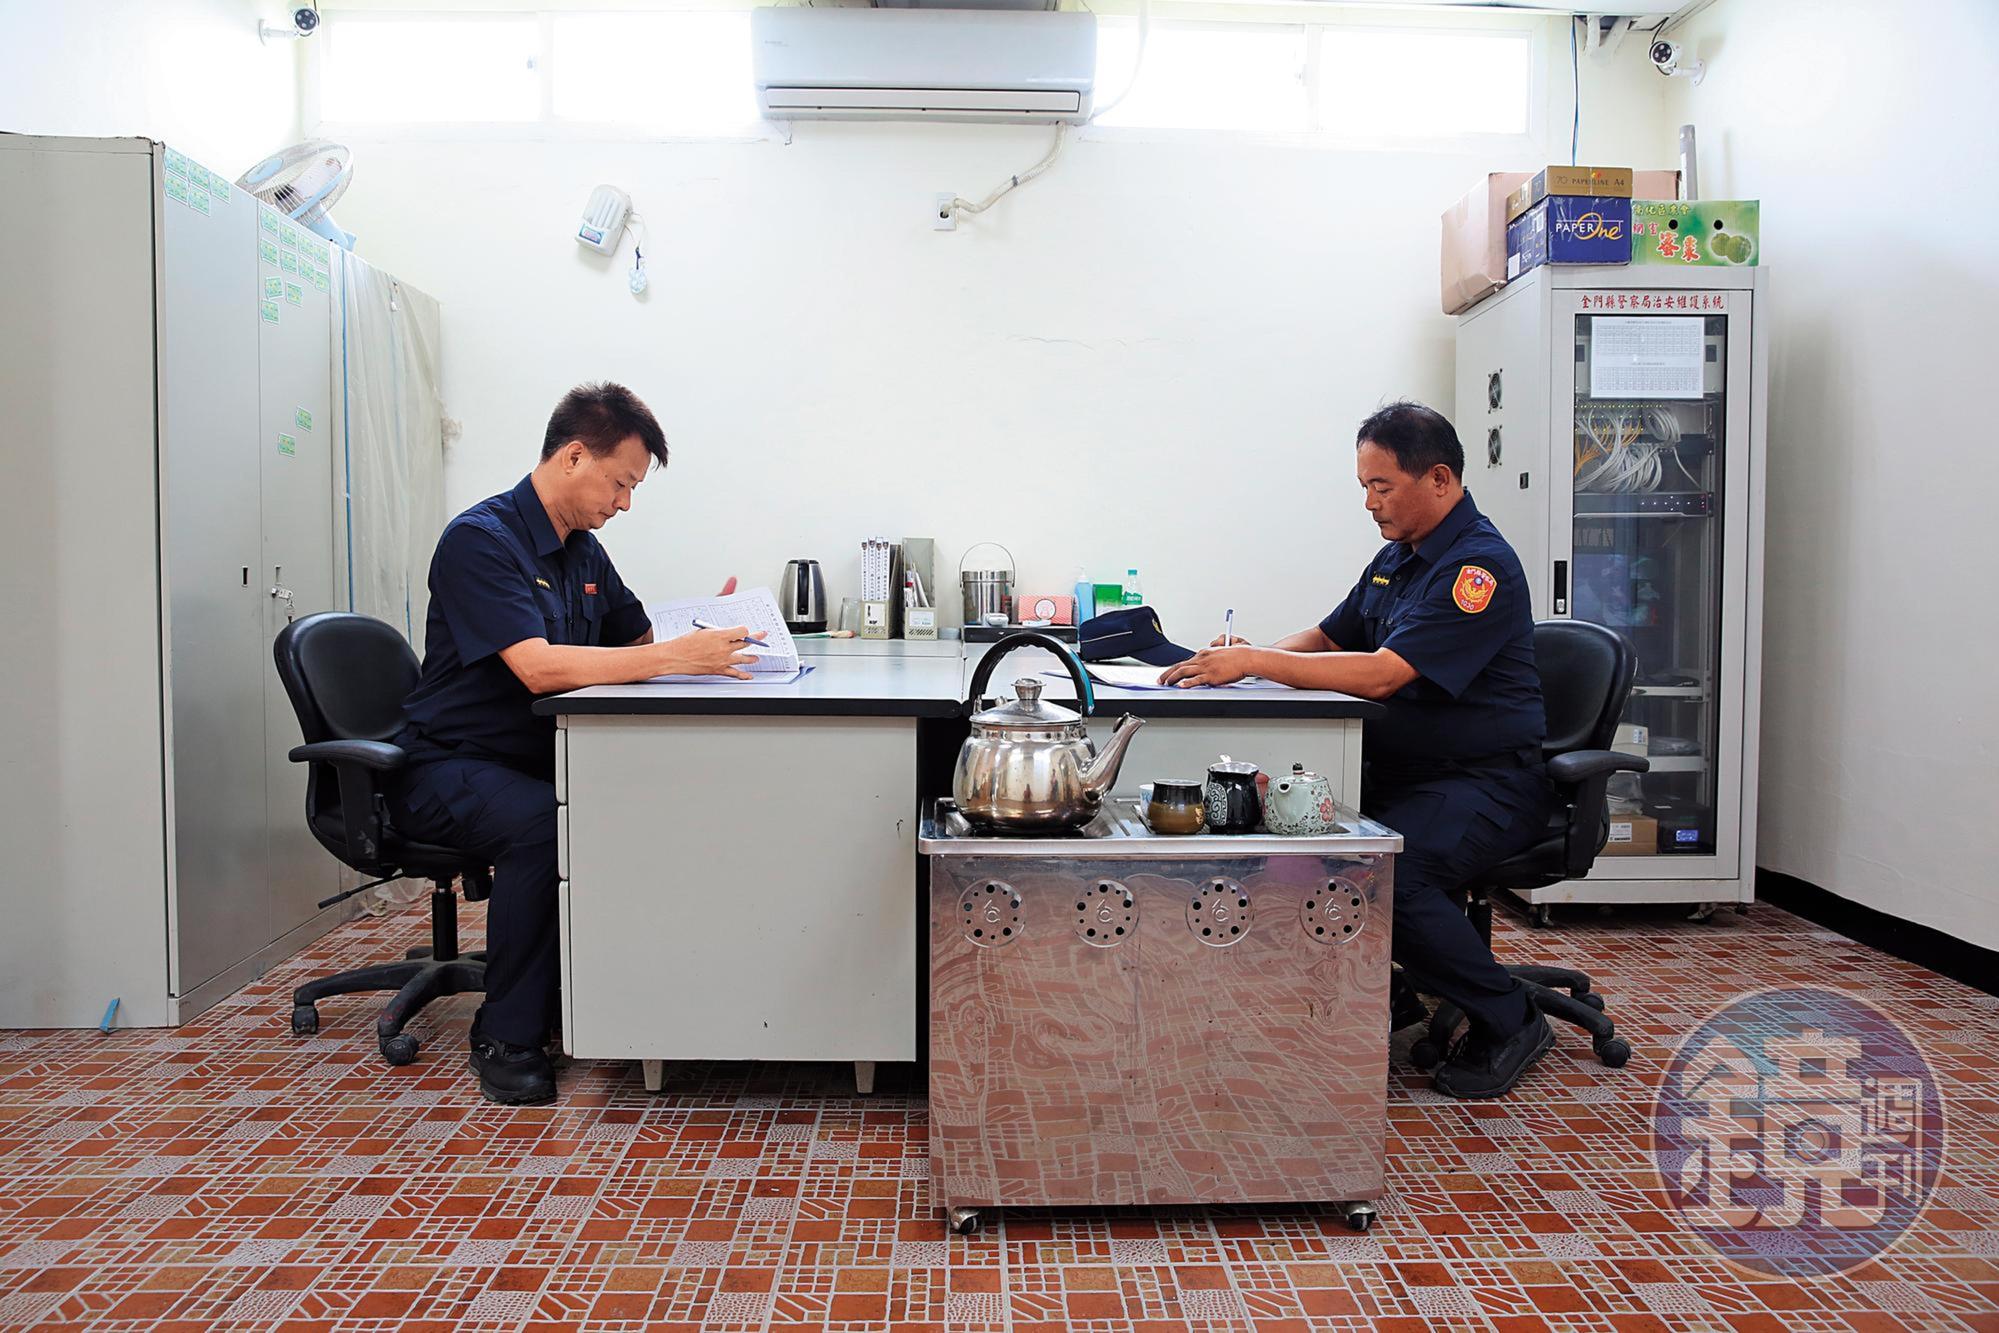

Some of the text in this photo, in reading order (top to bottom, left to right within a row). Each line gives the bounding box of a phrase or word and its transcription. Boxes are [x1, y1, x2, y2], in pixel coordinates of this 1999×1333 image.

[1614, 178, 1625, 186] A4
[1555, 222, 1594, 233] PAPER
[1580, 293, 1725, 310] 金門縣警察局治安維護系統
